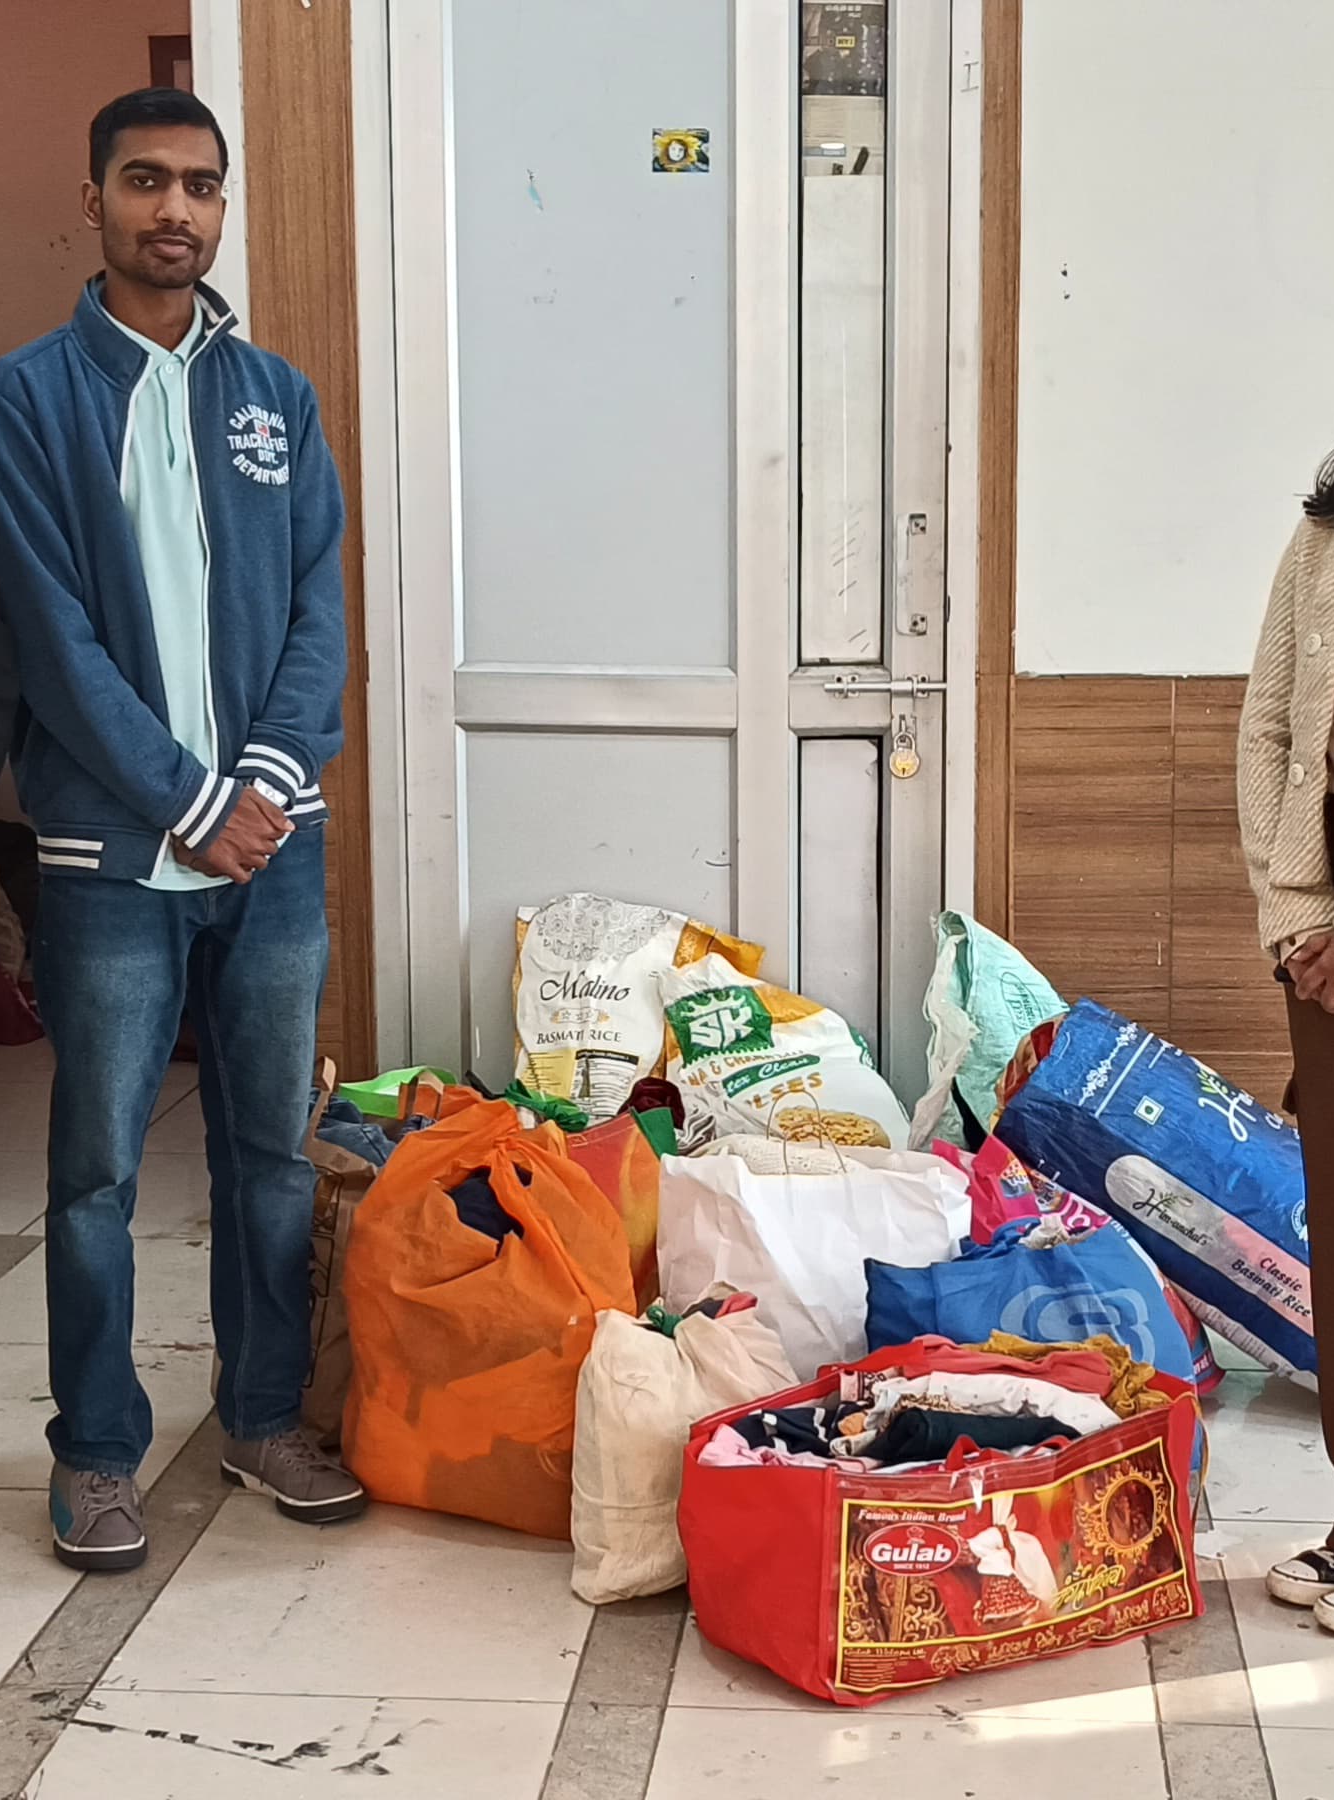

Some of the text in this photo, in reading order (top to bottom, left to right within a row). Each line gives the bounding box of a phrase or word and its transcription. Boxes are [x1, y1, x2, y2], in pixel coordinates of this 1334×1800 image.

[539, 969, 632, 1001] Malino
[536, 1029, 622, 1045] BASMATI RICE
[689, 1005, 754, 1050] SK
[1231, 1258, 1311, 1318] Basmati Rice
[1259, 1257, 1303, 1293] Classic
[858, 1508, 900, 1521] Famous
[901, 1510, 935, 1522] Indian
[870, 1542, 952, 1563] Gulab
